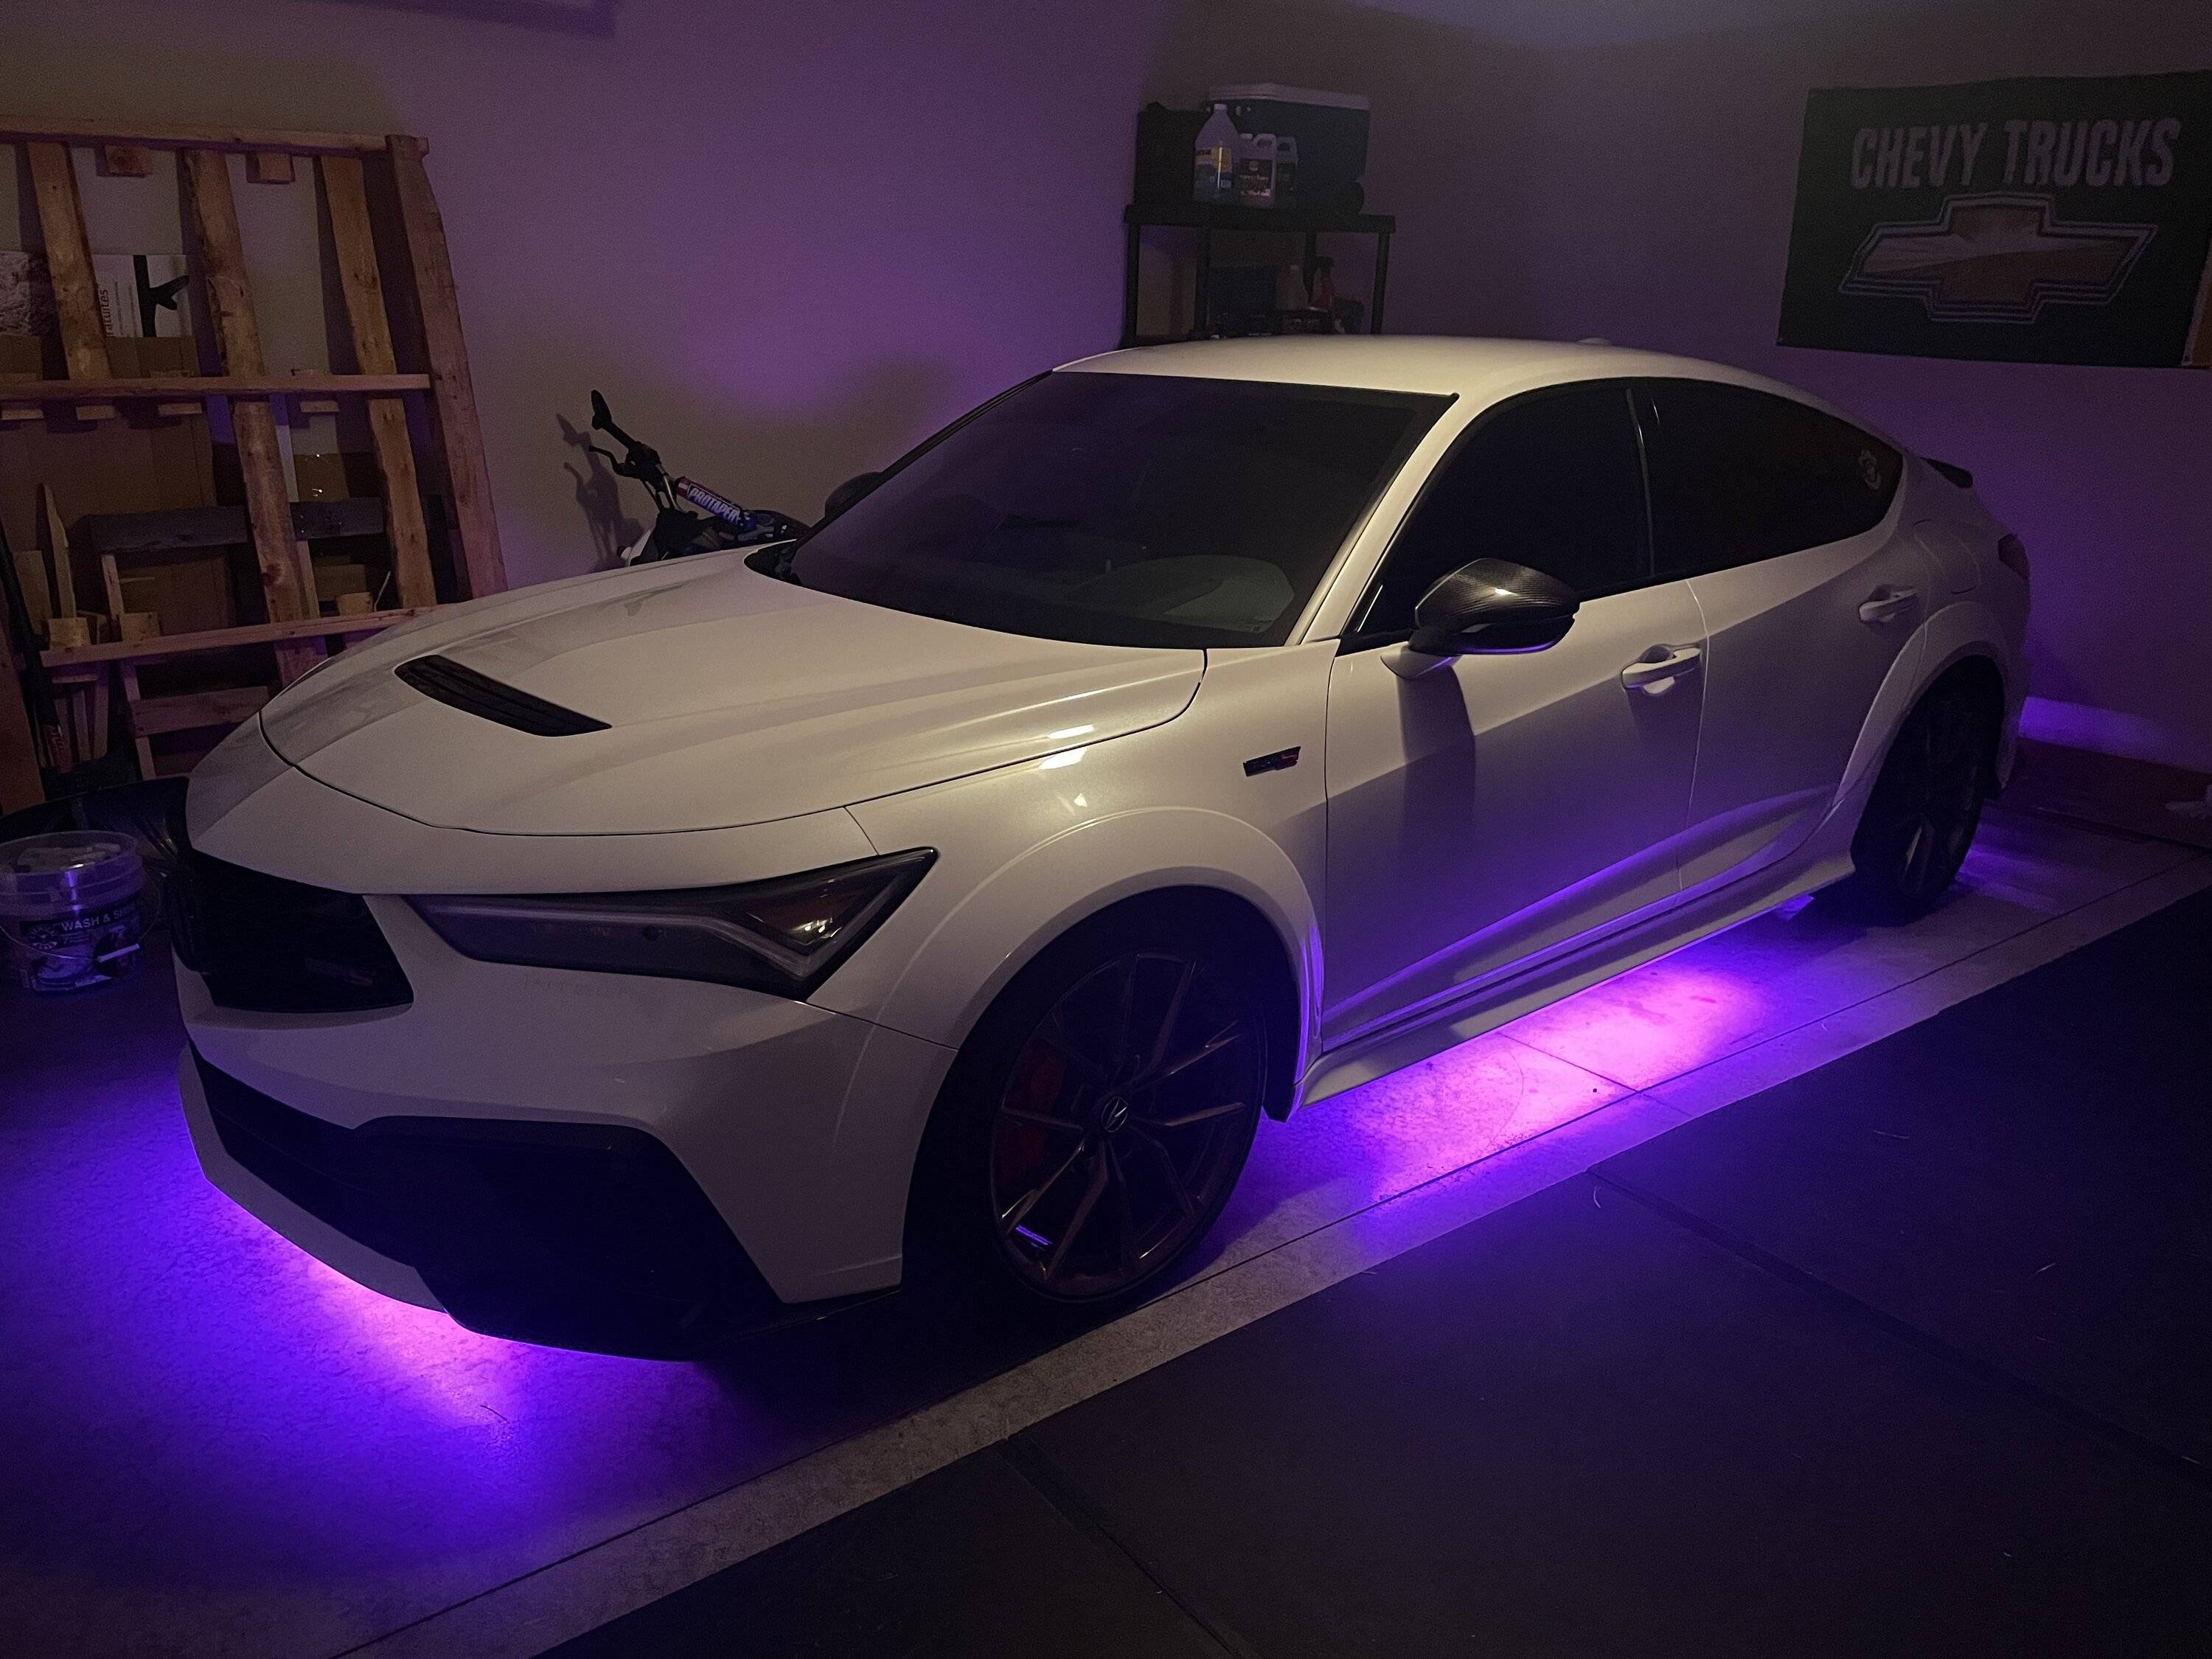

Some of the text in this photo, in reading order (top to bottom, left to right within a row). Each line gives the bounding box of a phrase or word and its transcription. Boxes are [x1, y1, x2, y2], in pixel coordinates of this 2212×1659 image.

[1851, 117, 2183, 189] CHEVY TRUCKS
[60, 916, 100, 931] WASH
[102, 914, 111, 923] &
